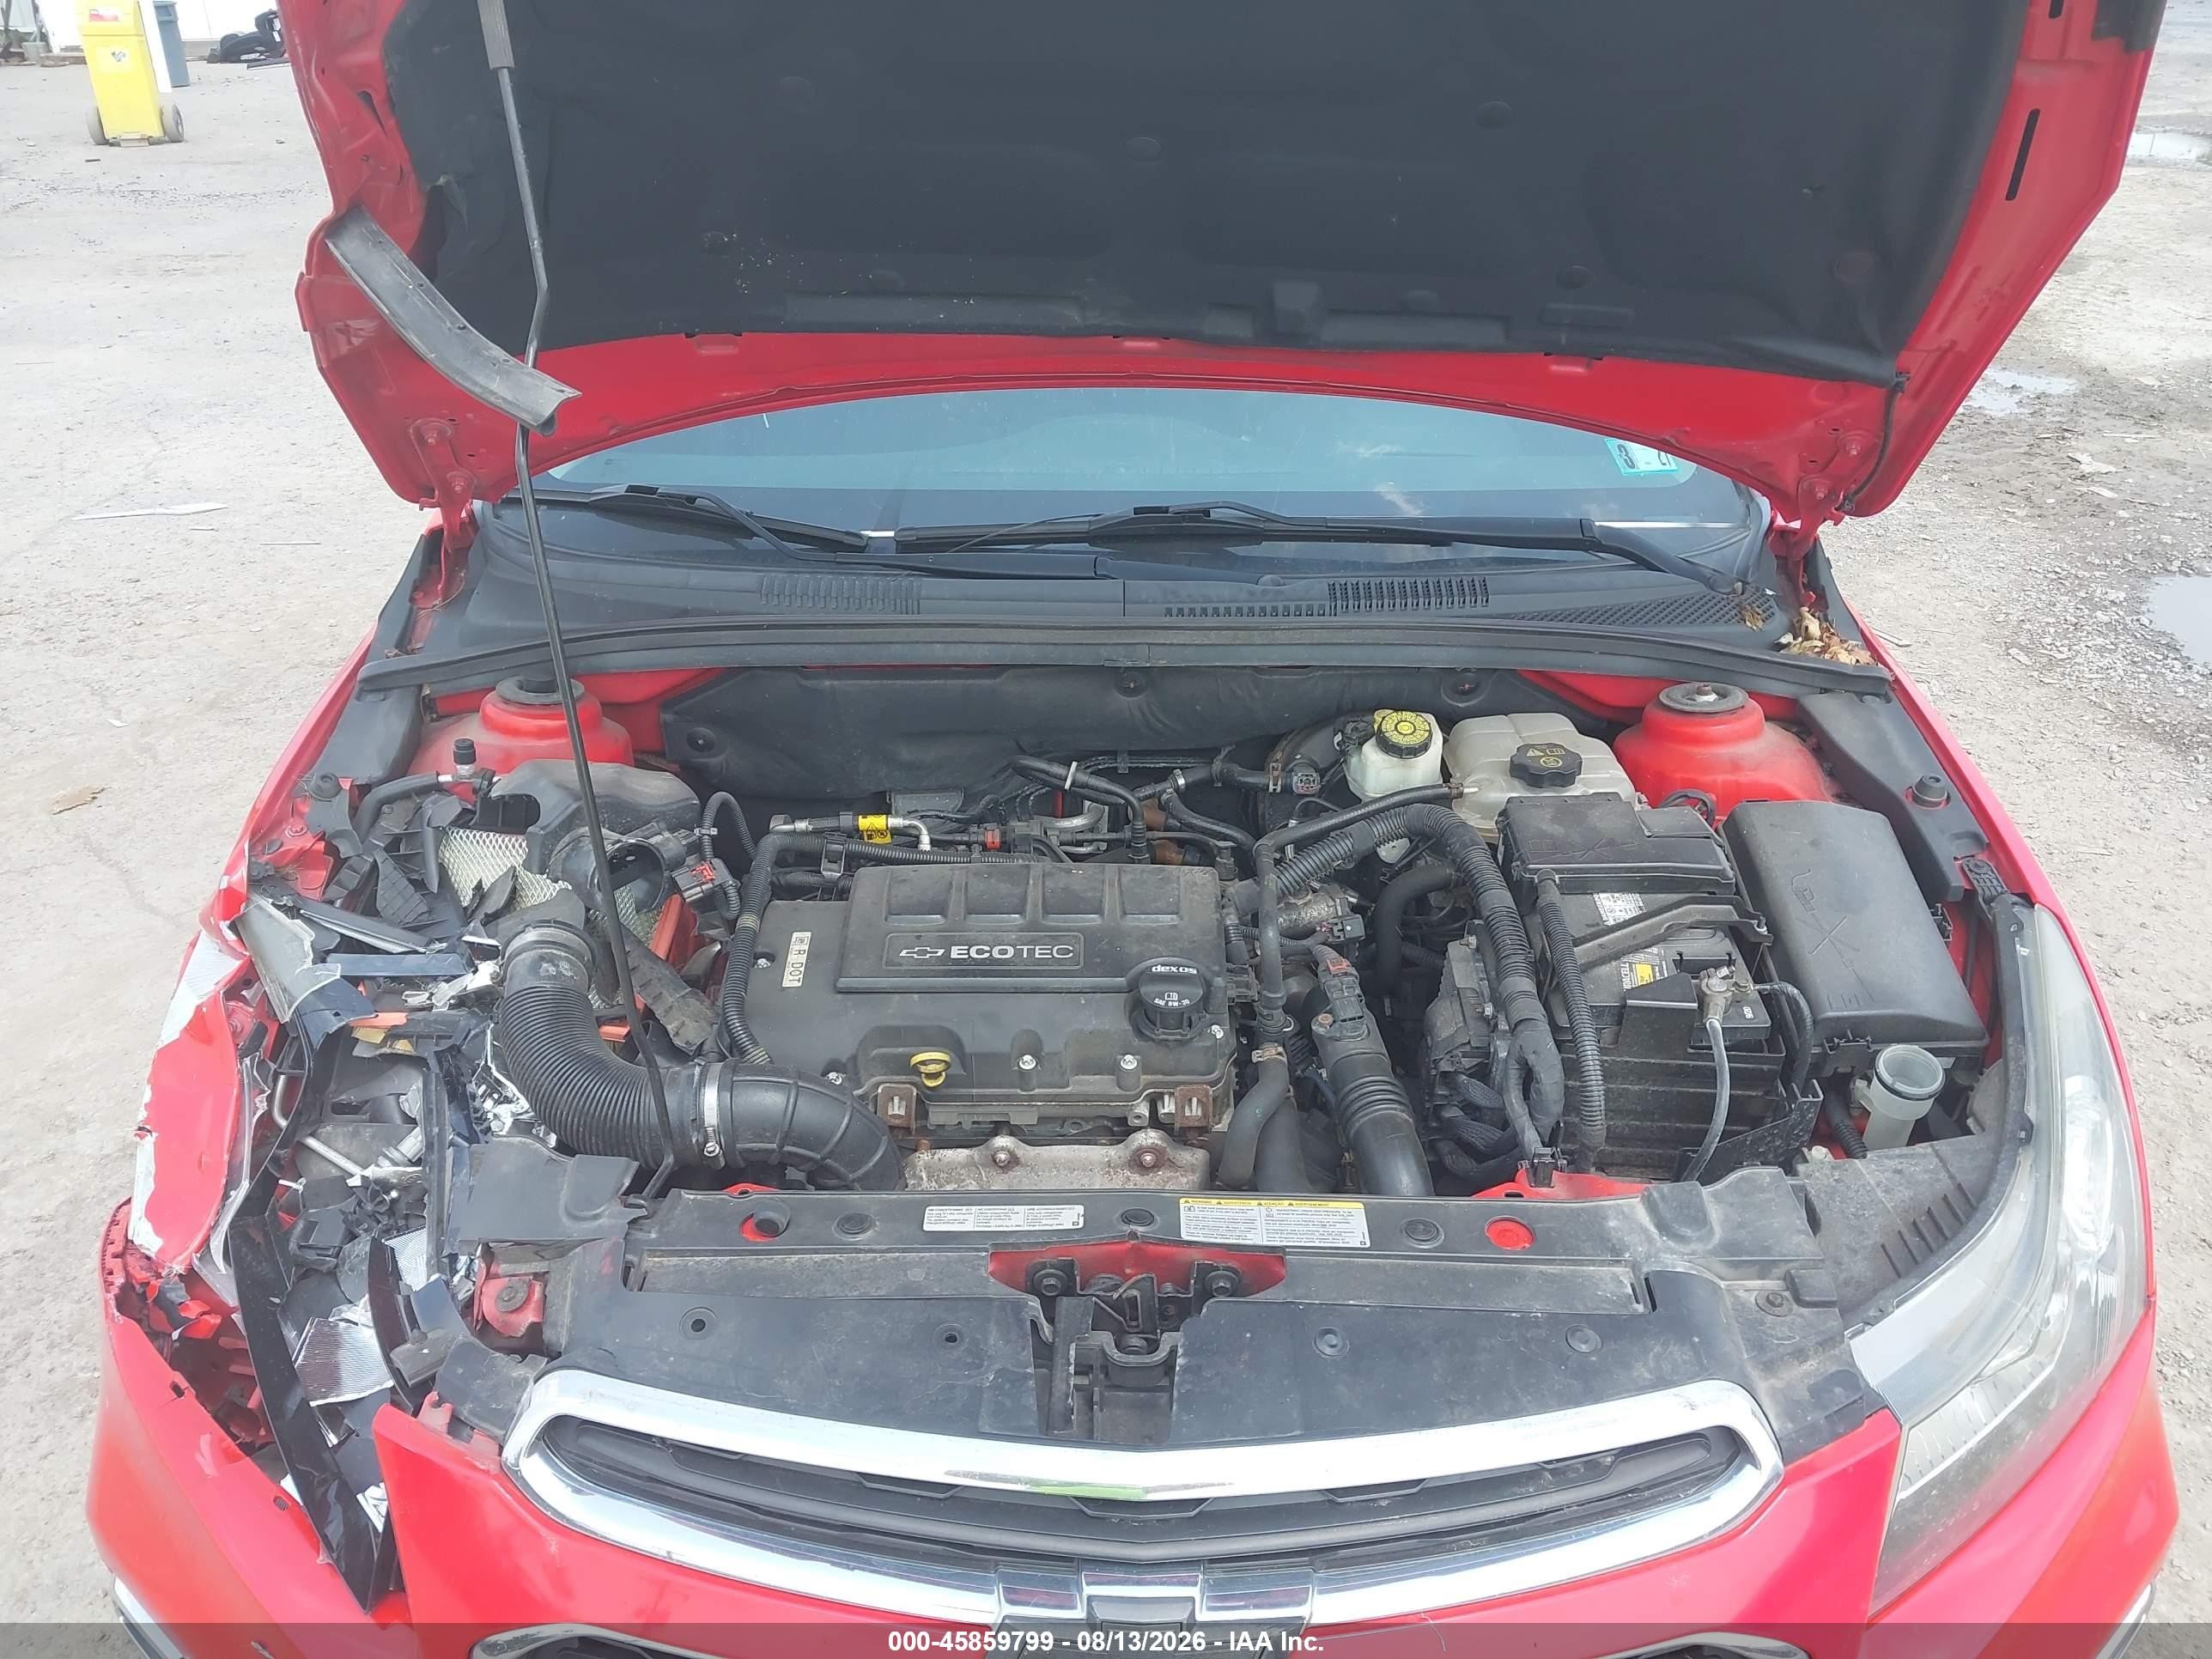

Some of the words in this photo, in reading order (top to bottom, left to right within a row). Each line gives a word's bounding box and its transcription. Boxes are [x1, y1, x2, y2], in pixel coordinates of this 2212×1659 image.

[950, 945, 1074, 959] ECOTEC
[1152, 964, 1198, 975] dexos
[1153, 998, 1166, 1006] SAE
[1167, 999, 1190, 1007] 5W-30
